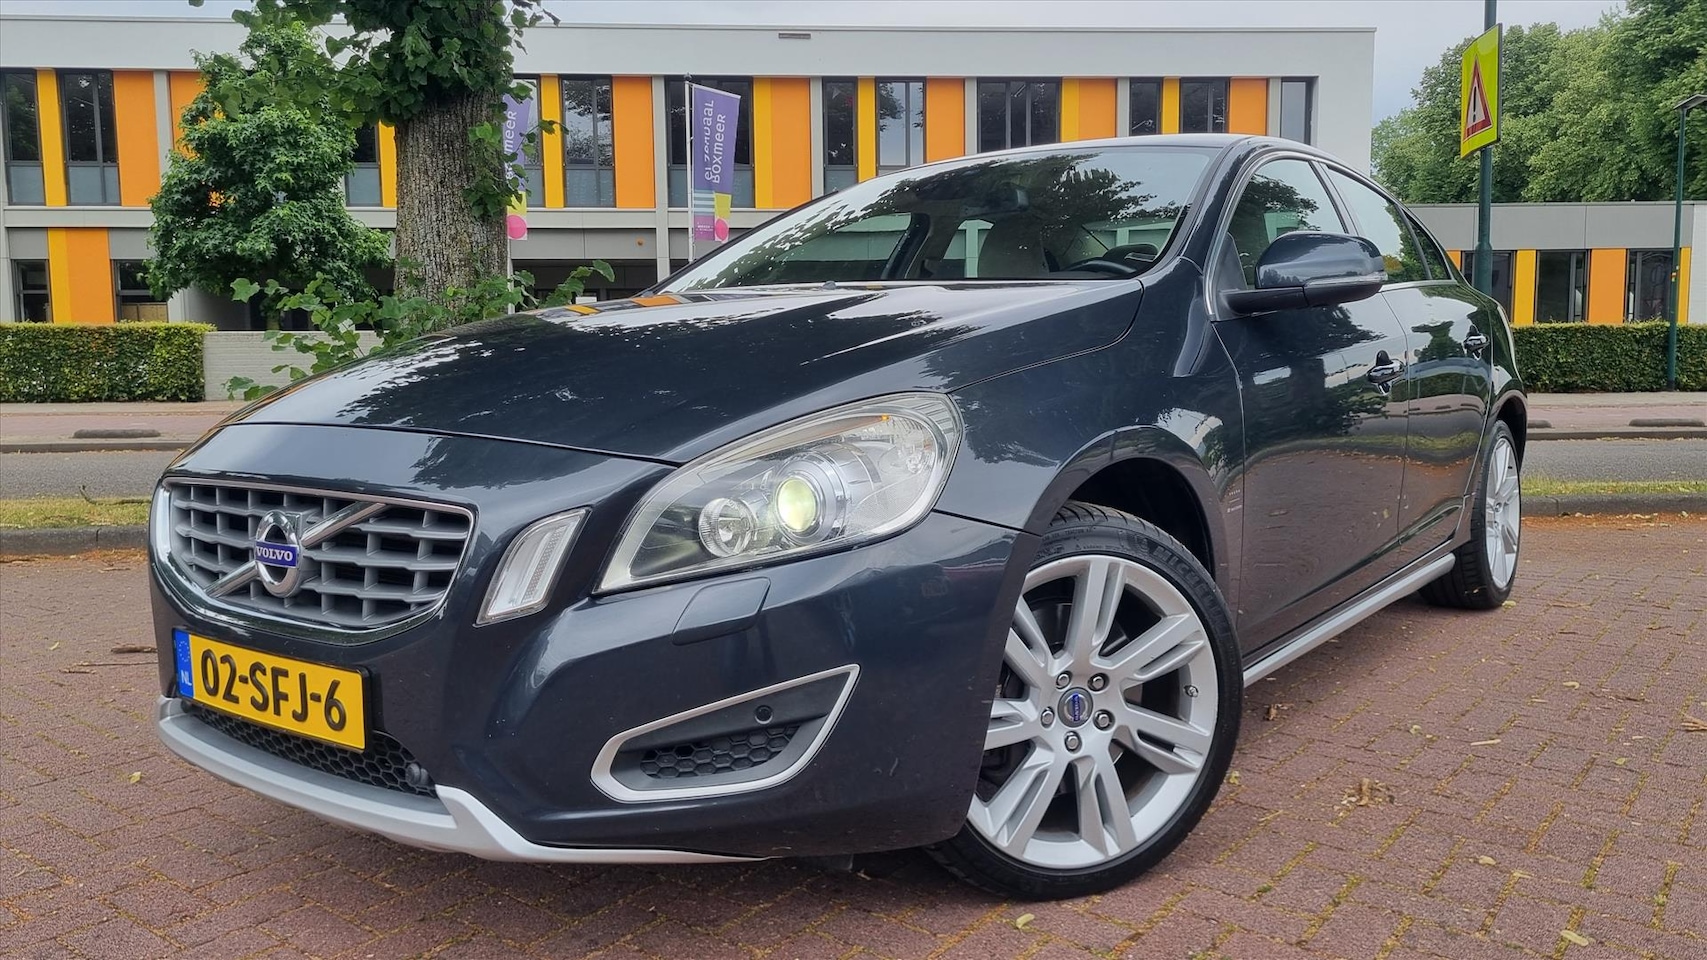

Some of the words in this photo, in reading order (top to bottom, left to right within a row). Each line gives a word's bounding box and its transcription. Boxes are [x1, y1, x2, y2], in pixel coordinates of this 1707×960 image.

[256, 546, 293, 561] VOLVO
[180, 669, 192, 685] NL
[201, 649, 347, 731] 02-SFJ-6
